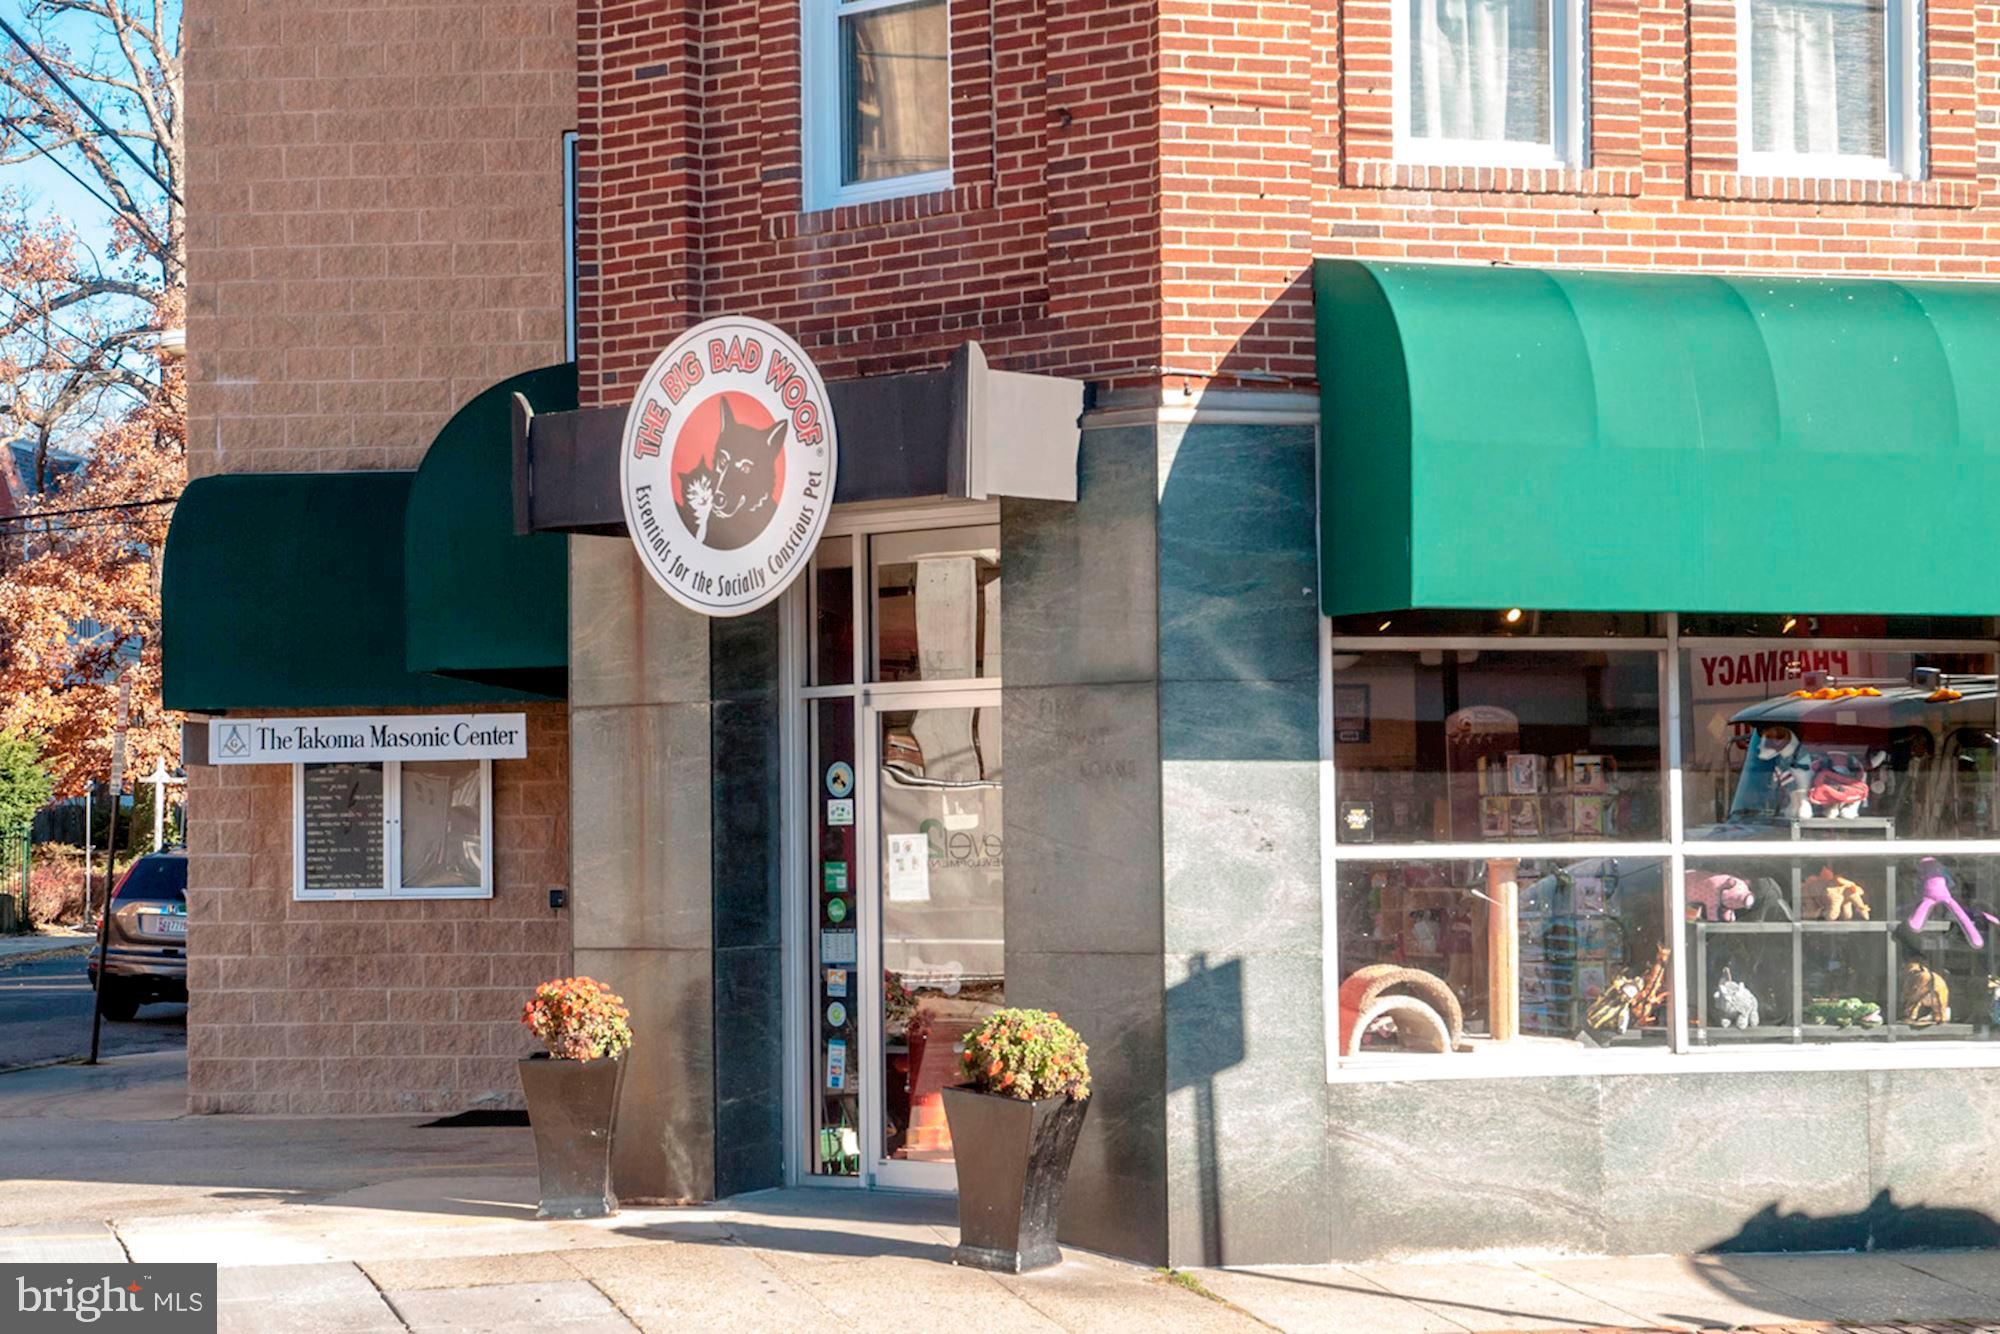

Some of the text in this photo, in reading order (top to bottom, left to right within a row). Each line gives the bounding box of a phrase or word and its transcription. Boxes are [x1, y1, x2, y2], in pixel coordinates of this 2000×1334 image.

[635, 335, 823, 461] THE BIG BAD WOOF
[635, 470, 823, 597] Essentials for the Socially Conscious Pet
[256, 722, 519, 751] The Takoma Masonic Center
